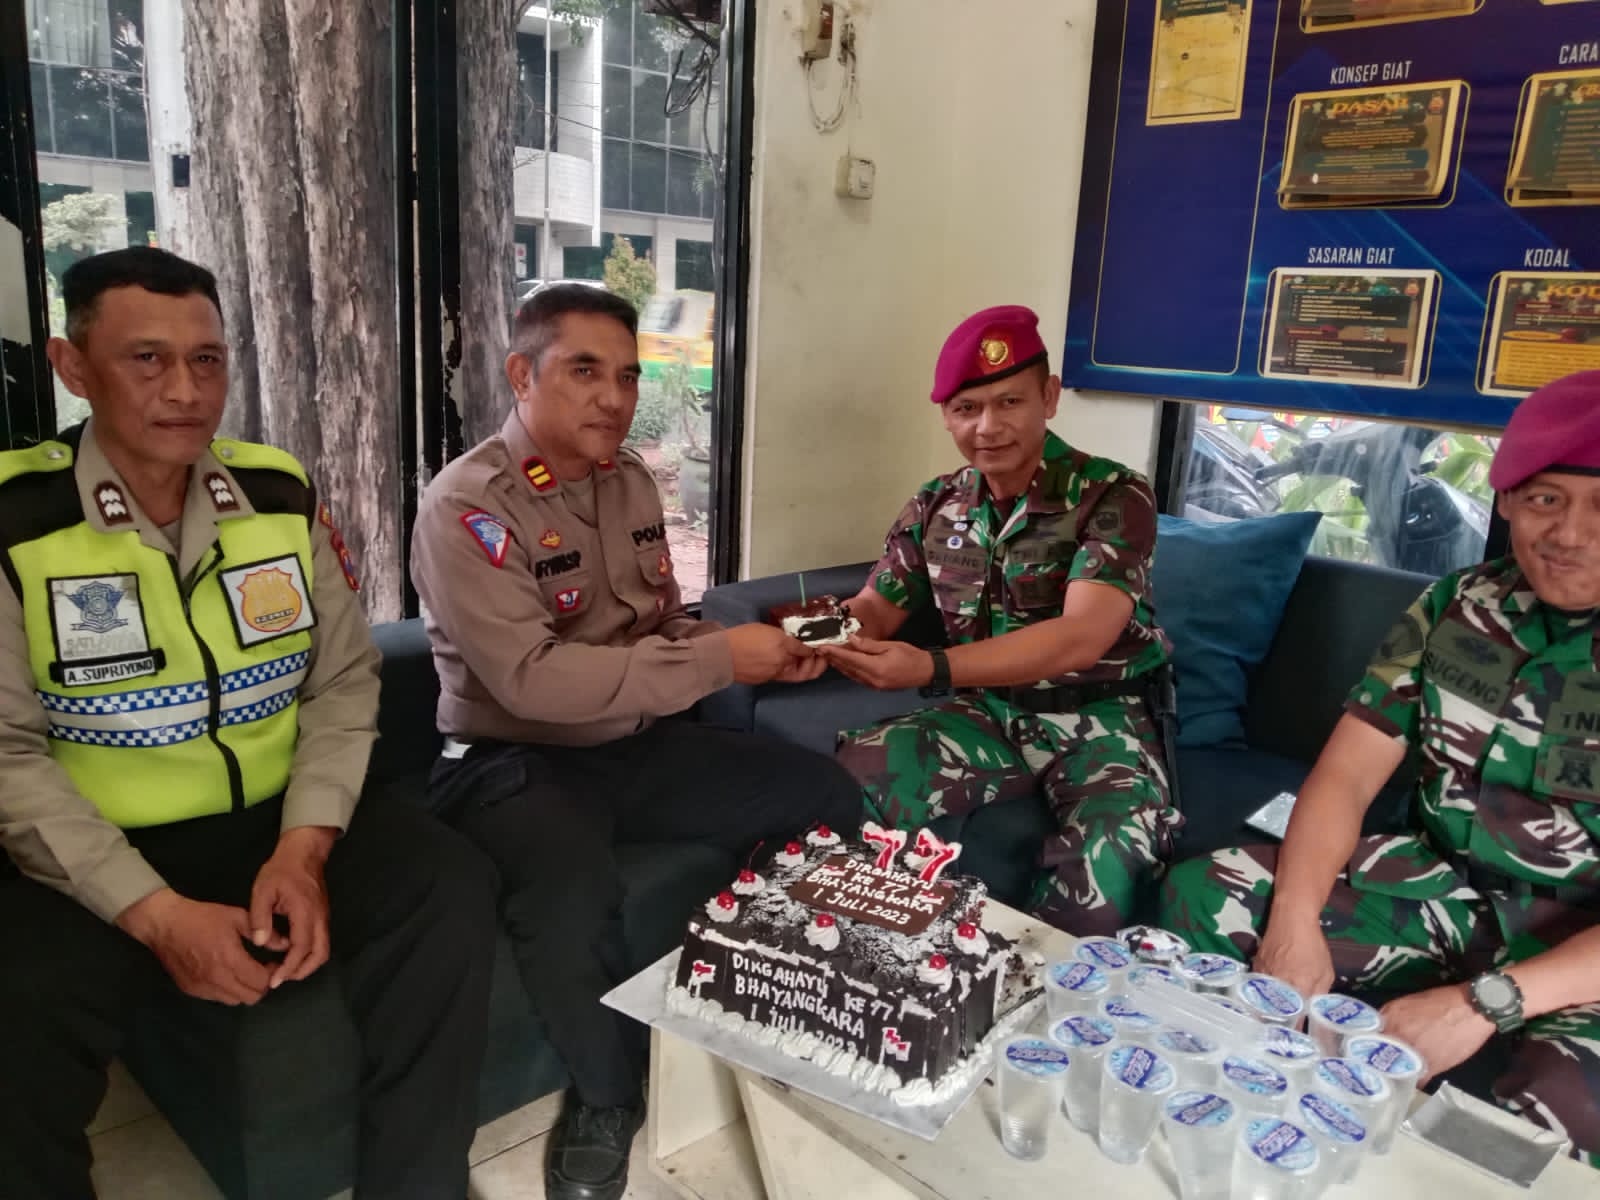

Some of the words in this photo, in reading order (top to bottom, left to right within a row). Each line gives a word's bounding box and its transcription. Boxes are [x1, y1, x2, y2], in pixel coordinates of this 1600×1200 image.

[1558, 43, 1599, 65] CARA
[1330, 64, 1378, 85] KONSEP
[1382, 60, 1413, 81] GIAT
[1307, 247, 1363, 264] SASARAN
[1366, 247, 1395, 265] GIAT
[1523, 248, 1571, 267] KODAL
[806, 871, 934, 915] BHAYANGKARA
[851, 872, 875, 885] KE
[882, 880, 909, 894] 77
[826, 891, 865, 911] JULI
[866, 905, 912, 925] 2023
[734, 973, 865, 1039] BHAYANGKARA
[843, 992, 867, 1014] KE
